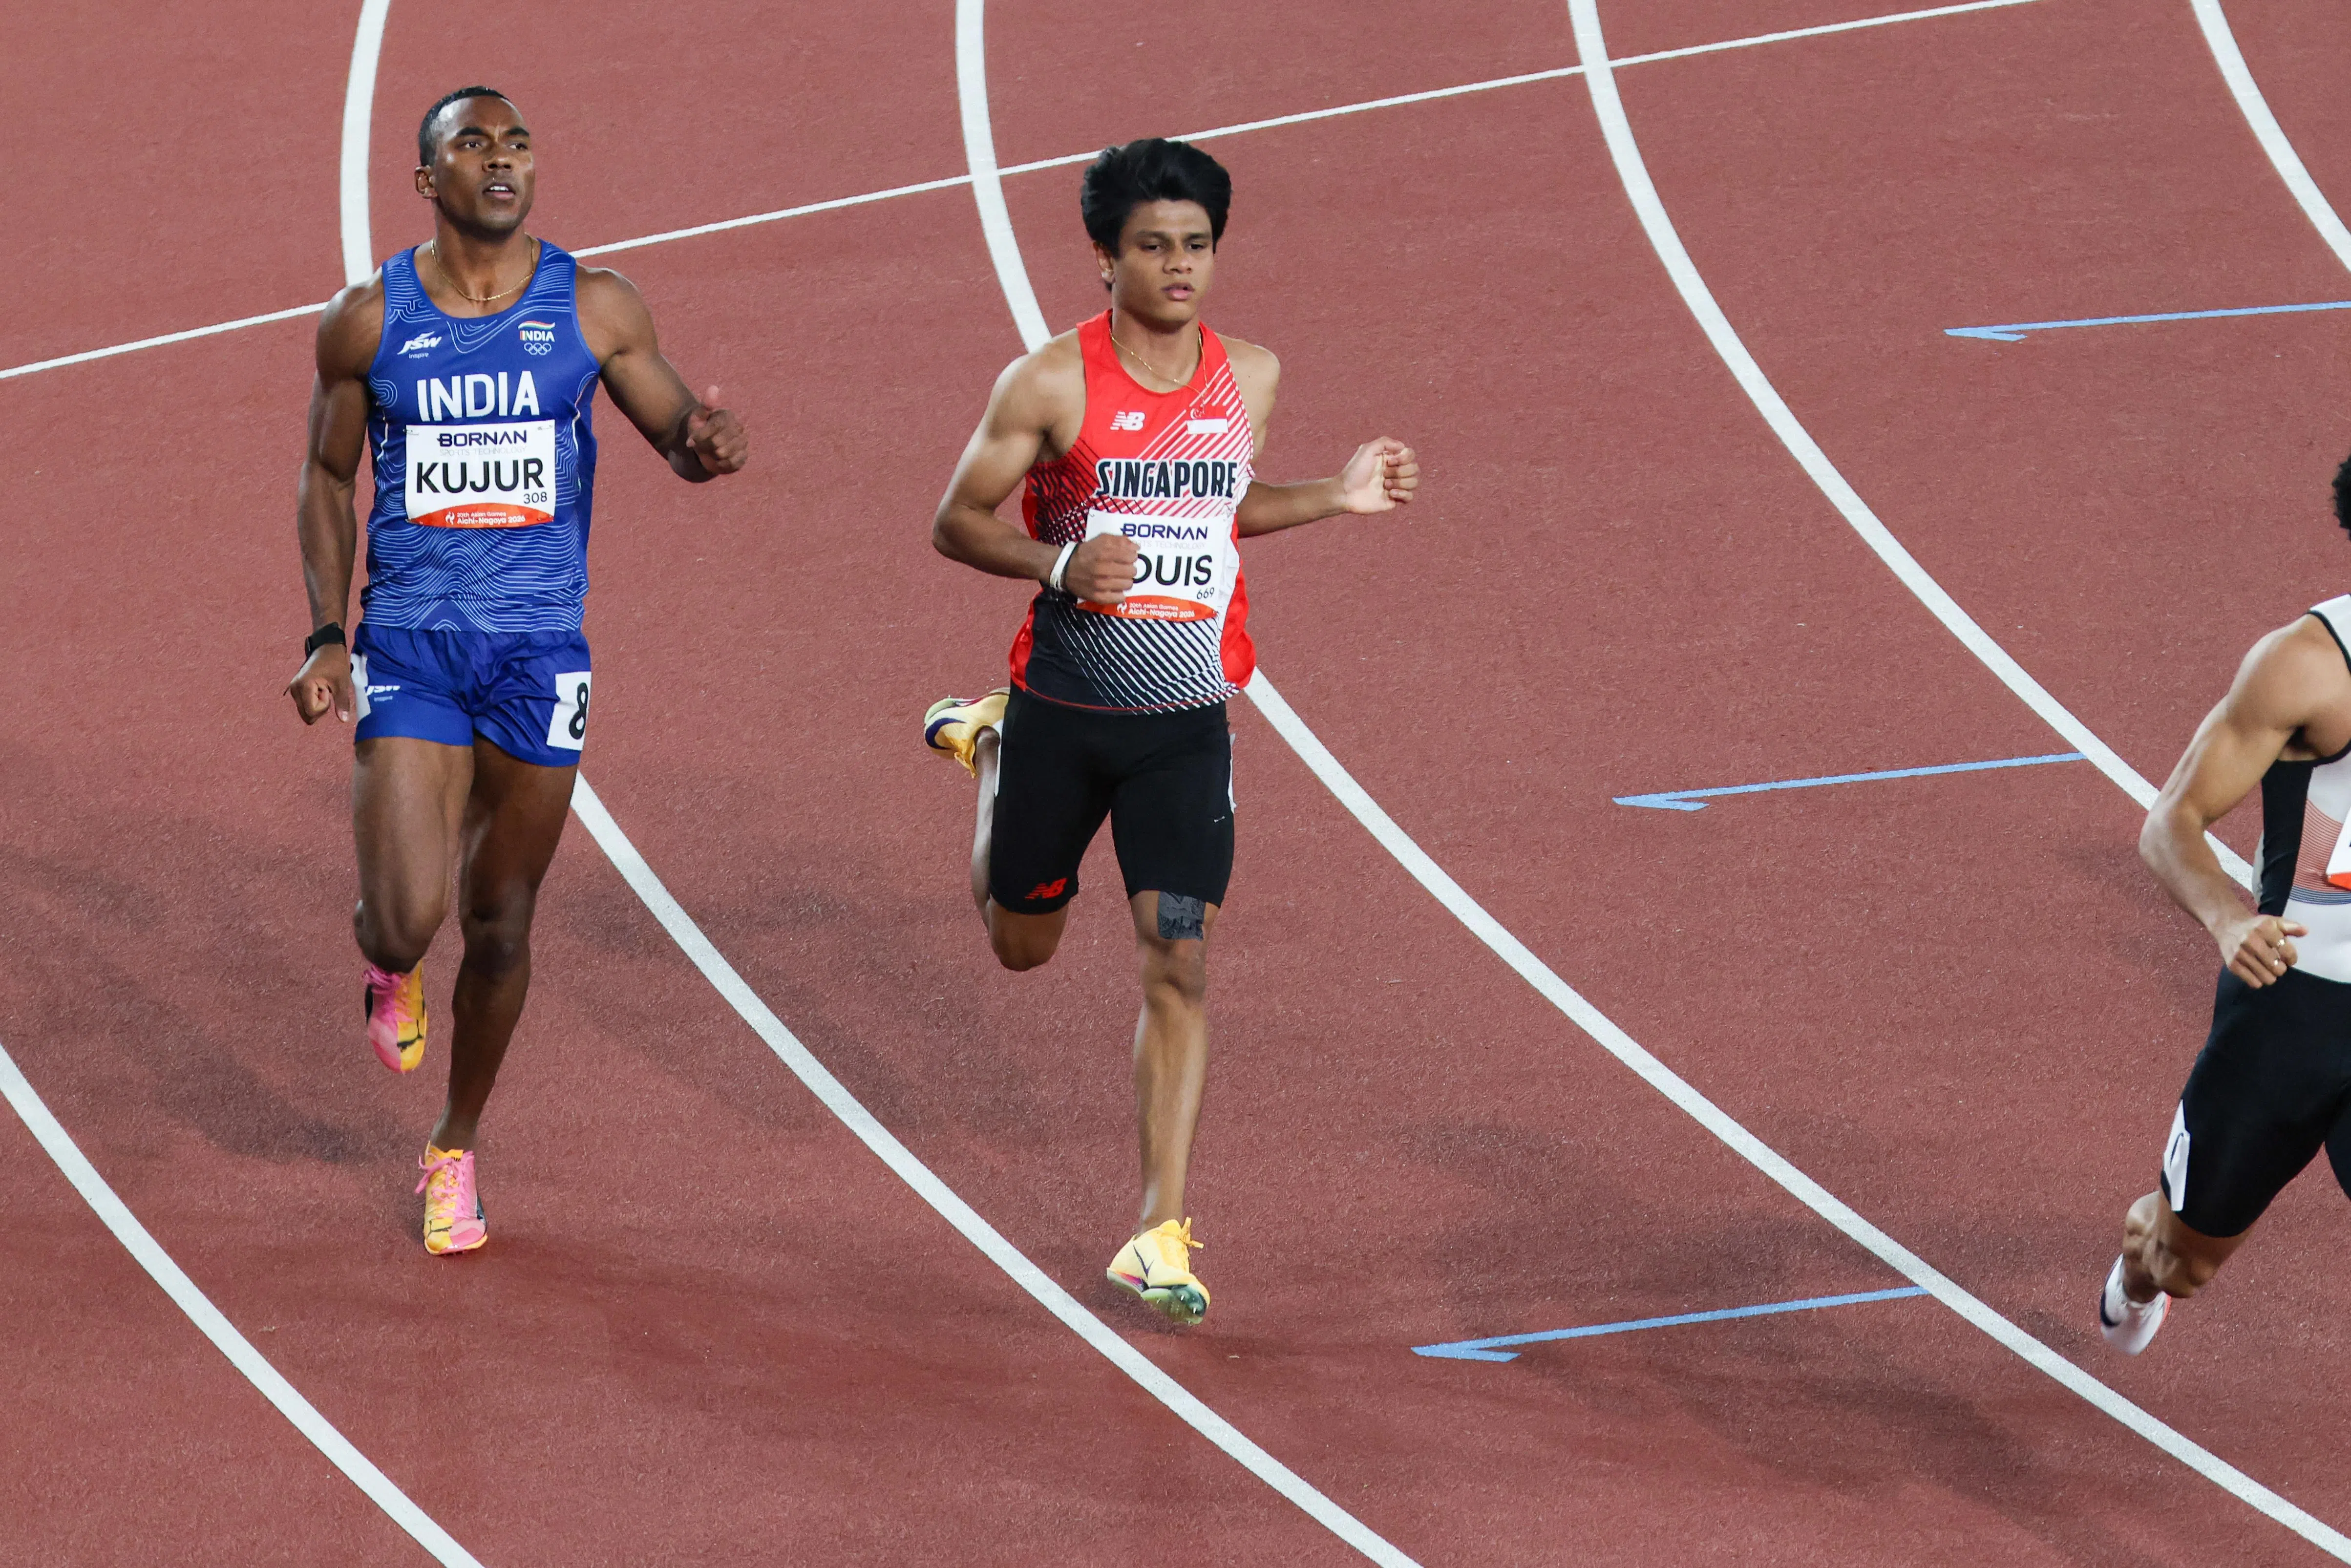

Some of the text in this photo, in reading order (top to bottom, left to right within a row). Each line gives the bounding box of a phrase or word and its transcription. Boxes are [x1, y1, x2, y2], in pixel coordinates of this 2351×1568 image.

[520, 330, 555, 342] INDIA
[397, 336, 442, 355] JSW
[417, 370, 540, 422] INDIA
[437, 429, 527, 447] BORNAN
[473, 446, 527, 456] TECHNOLOGY
[416, 458, 545, 494] KUJUR
[1096, 461, 1238, 498] SINGAPORE
[523, 491, 548, 504] 308
[457, 515, 526, 525] Aichi-Nagoya 2026
[1120, 523, 1208, 540] BORNAN
[1156, 540, 1206, 550] TECHNOLOGY
[1133, 553, 1212, 587] OUIS
[1197, 587, 1214, 599] 669
[1128, 608, 1178, 618] Aichi-Nagoya
[569, 682, 588, 740] 8
